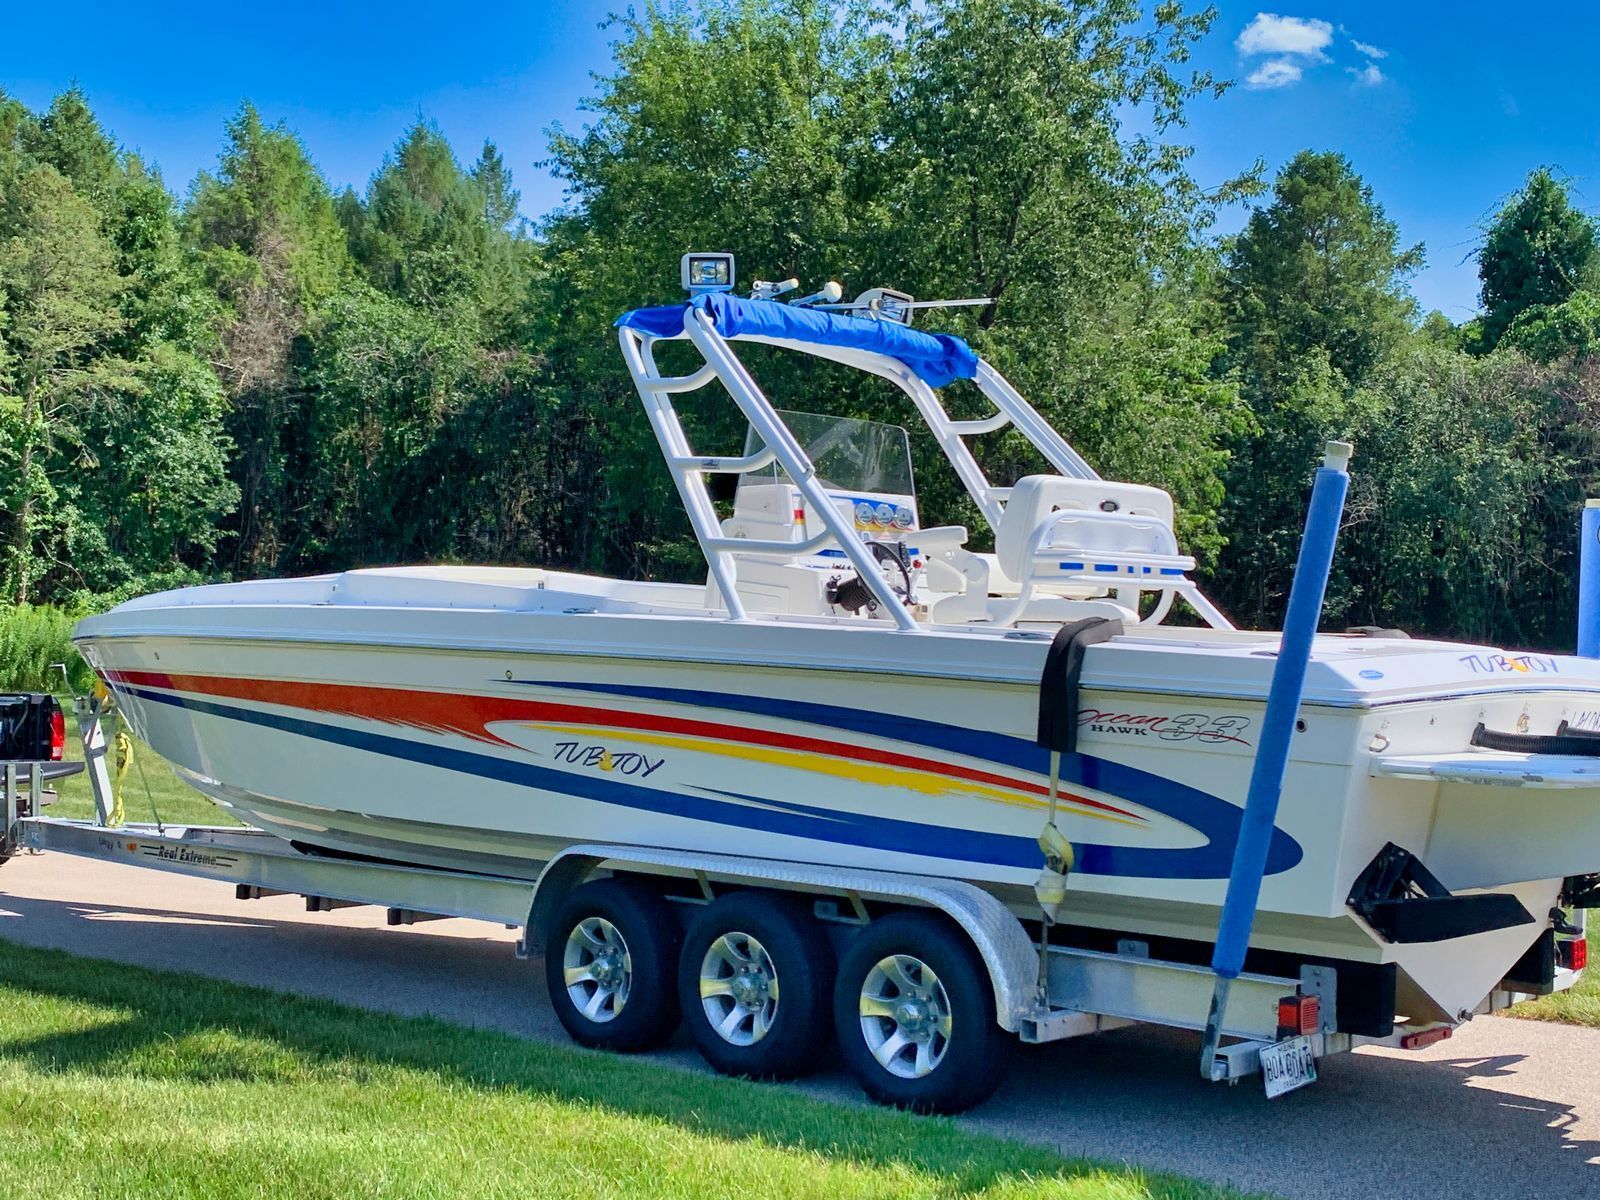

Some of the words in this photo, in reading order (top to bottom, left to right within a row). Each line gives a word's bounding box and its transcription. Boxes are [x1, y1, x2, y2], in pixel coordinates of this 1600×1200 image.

[1091, 724, 1148, 736] HAWK
[1158, 714, 1251, 743] 33
[554, 742, 605, 766] TUB
[611, 752, 666, 778] TOY
[158, 845, 178, 859] Real
[179, 848, 217, 865] Extreme
